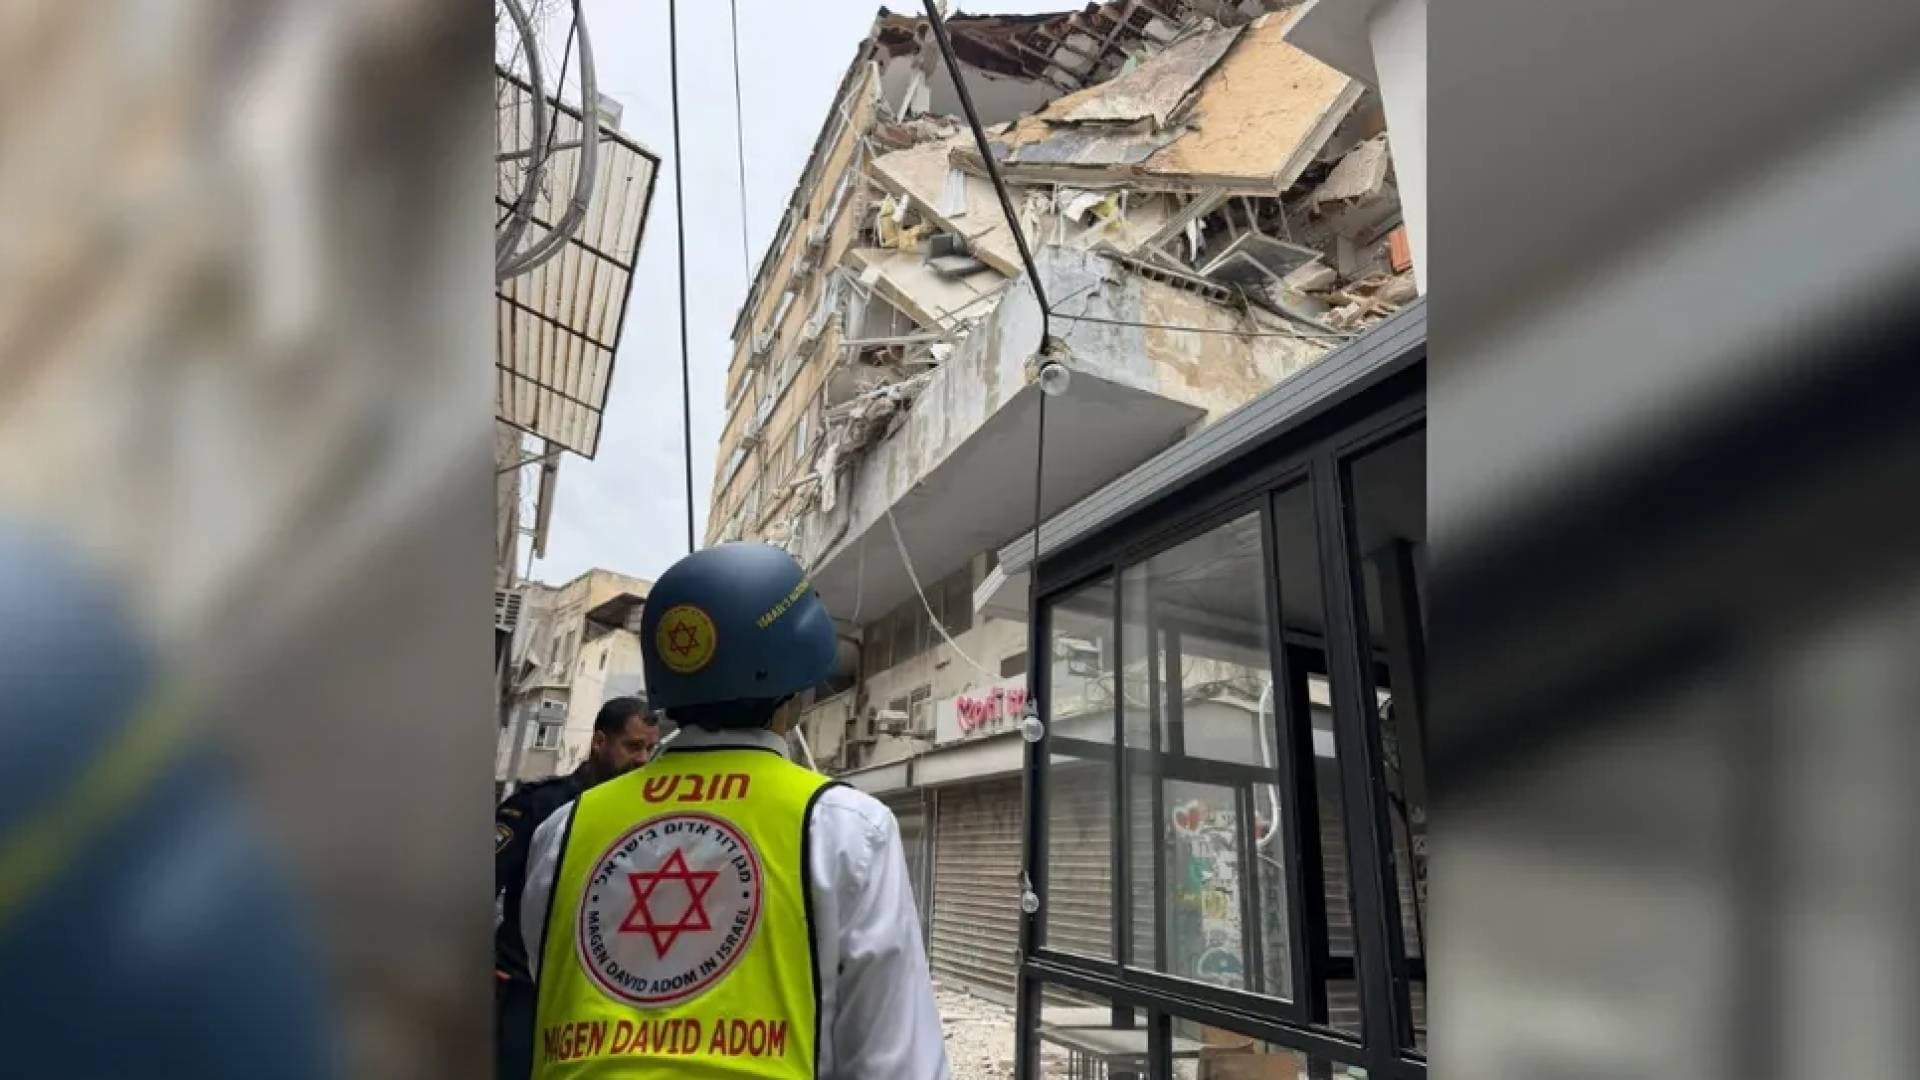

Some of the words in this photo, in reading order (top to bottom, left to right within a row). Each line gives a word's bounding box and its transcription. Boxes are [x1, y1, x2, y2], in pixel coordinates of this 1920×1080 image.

[642, 774, 750, 803] חובש
[664, 822, 711, 835] אדום
[715, 828, 739, 853] דוד
[731, 855, 750, 883] מגן
[588, 910, 609, 965] MAGEN
[606, 962, 648, 992] DAVID
[650, 970, 698, 993] ADOM
[700, 957, 717, 975] IN
[717, 909, 750, 960] ISRAEL
[609, 1019, 702, 1055] DAVID
[708, 1019, 788, 1057] ADOM
